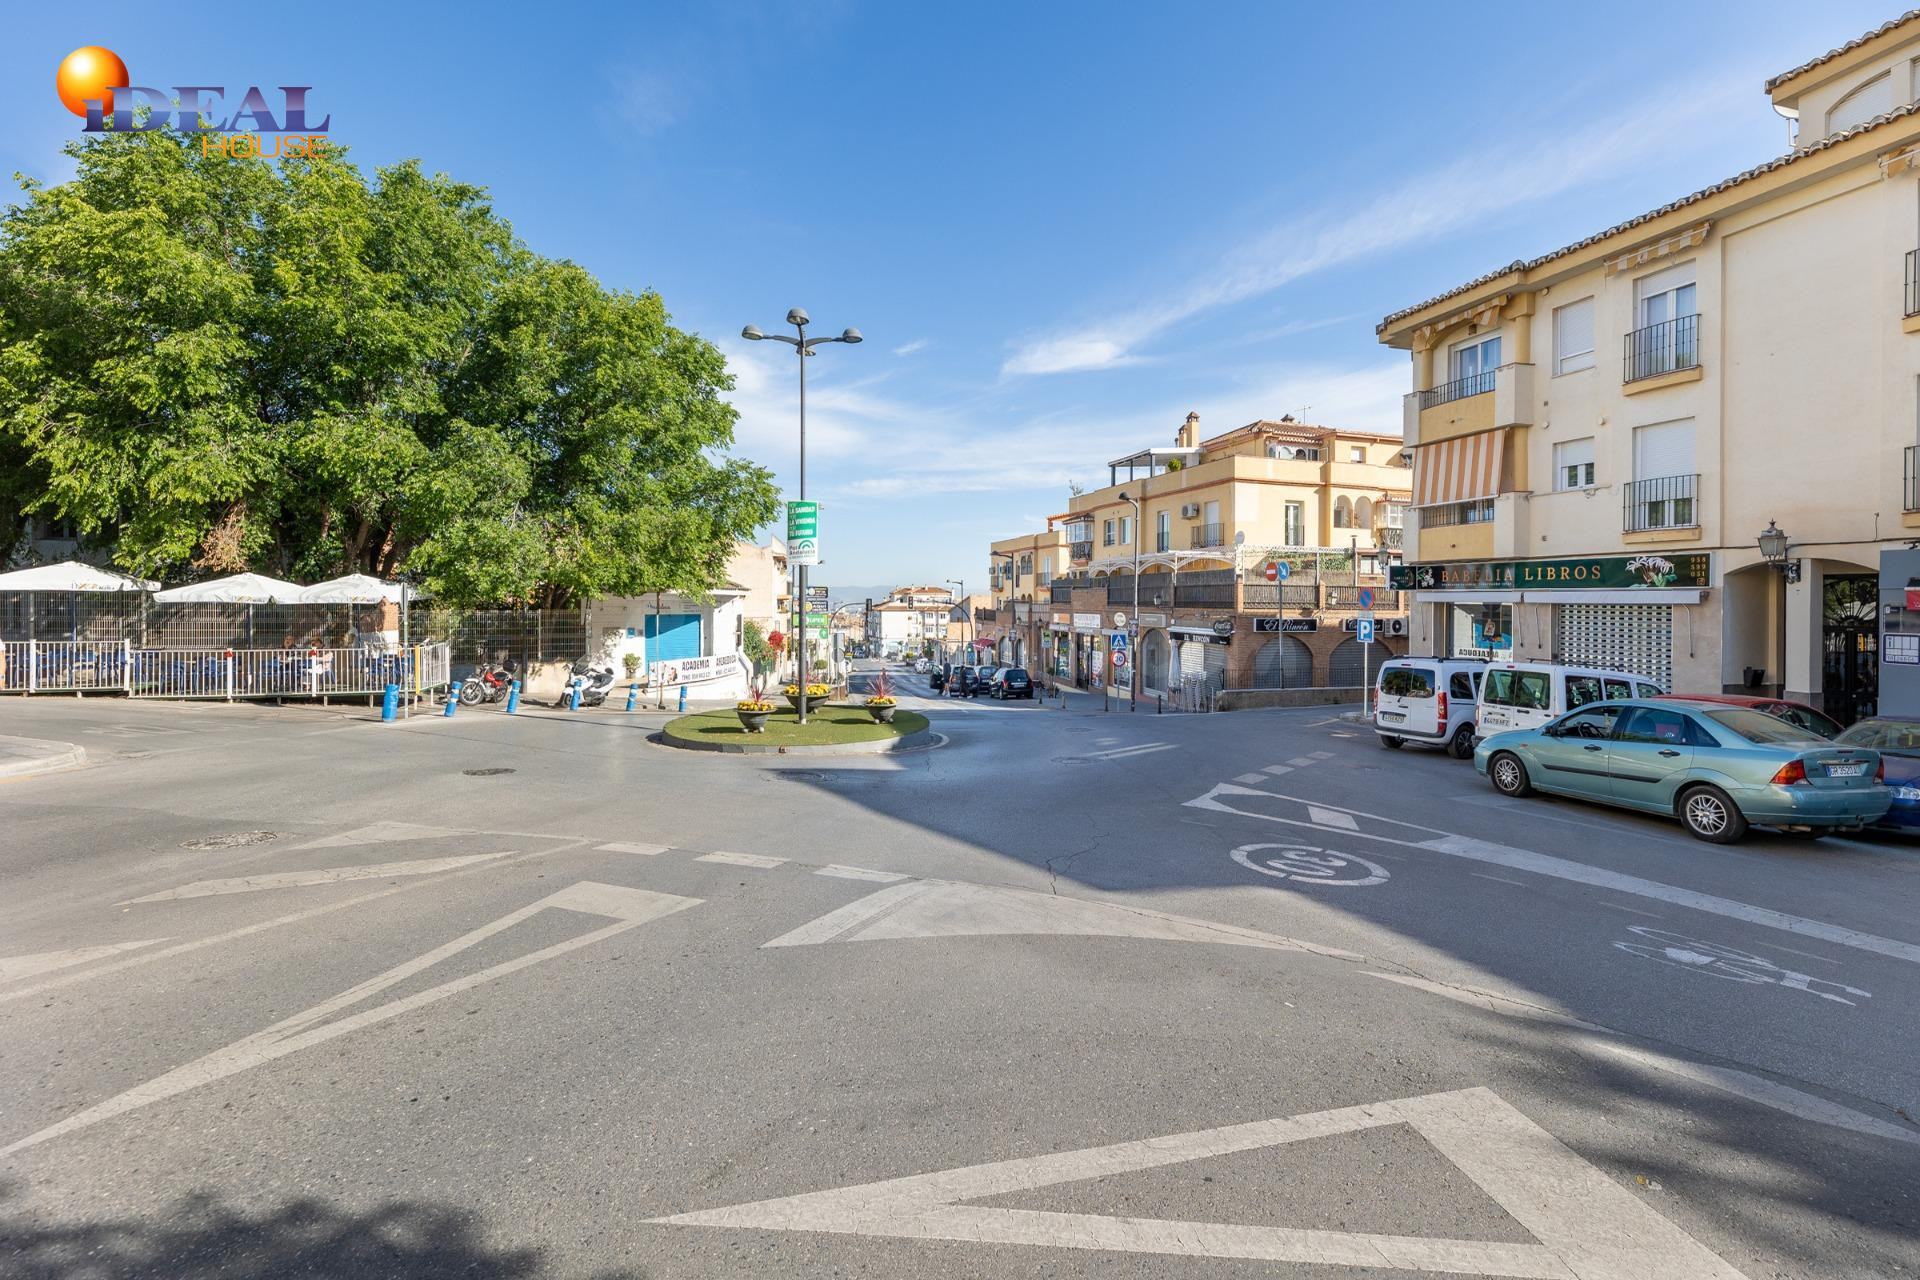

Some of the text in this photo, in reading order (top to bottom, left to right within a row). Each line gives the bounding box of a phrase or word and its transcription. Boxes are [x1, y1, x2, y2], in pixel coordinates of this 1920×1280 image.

[1442, 565, 1600, 582] BABELIA LIBROS
[1264, 619, 1309, 632] El Rincón
[1361, 621, 1371, 640] P
[682, 659, 710, 671] ACADEMIA
